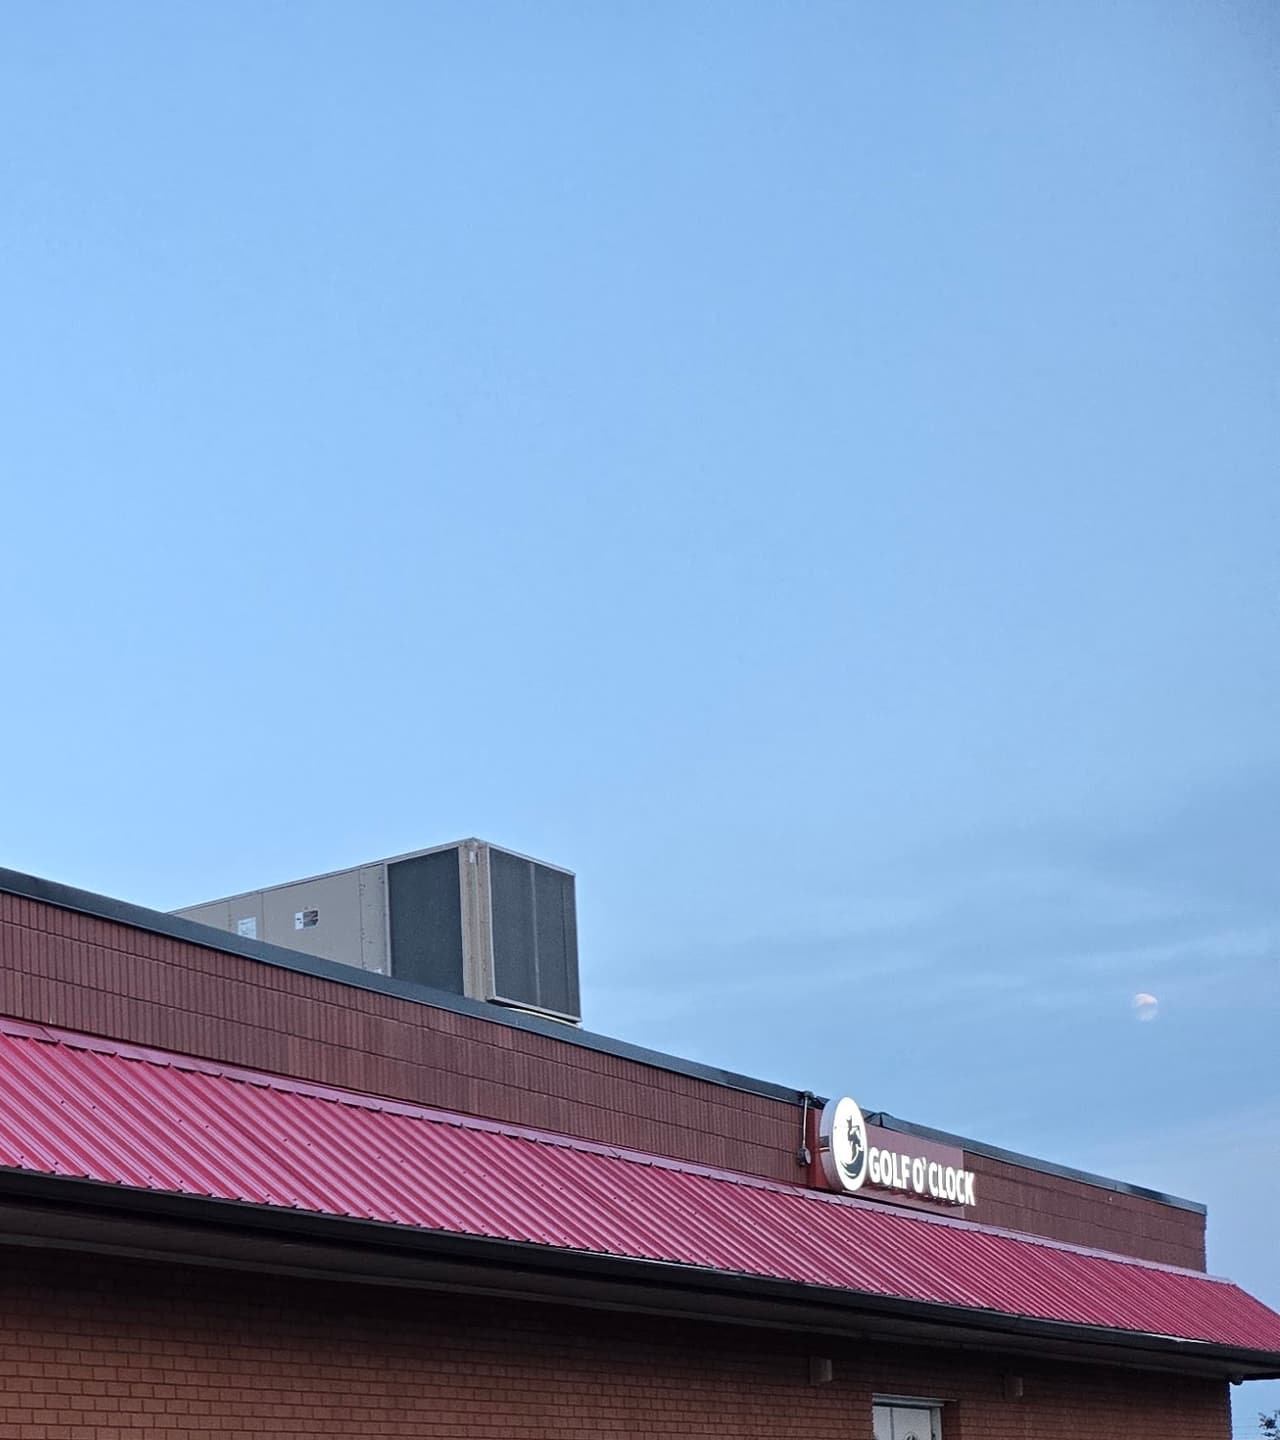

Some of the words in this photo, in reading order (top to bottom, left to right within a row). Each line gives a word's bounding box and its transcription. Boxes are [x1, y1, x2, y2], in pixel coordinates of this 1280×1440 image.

[868, 1147, 910, 1190] GOLF
[912, 1156, 927, 1194] O'
[928, 1161, 977, 1207] CLOCK
